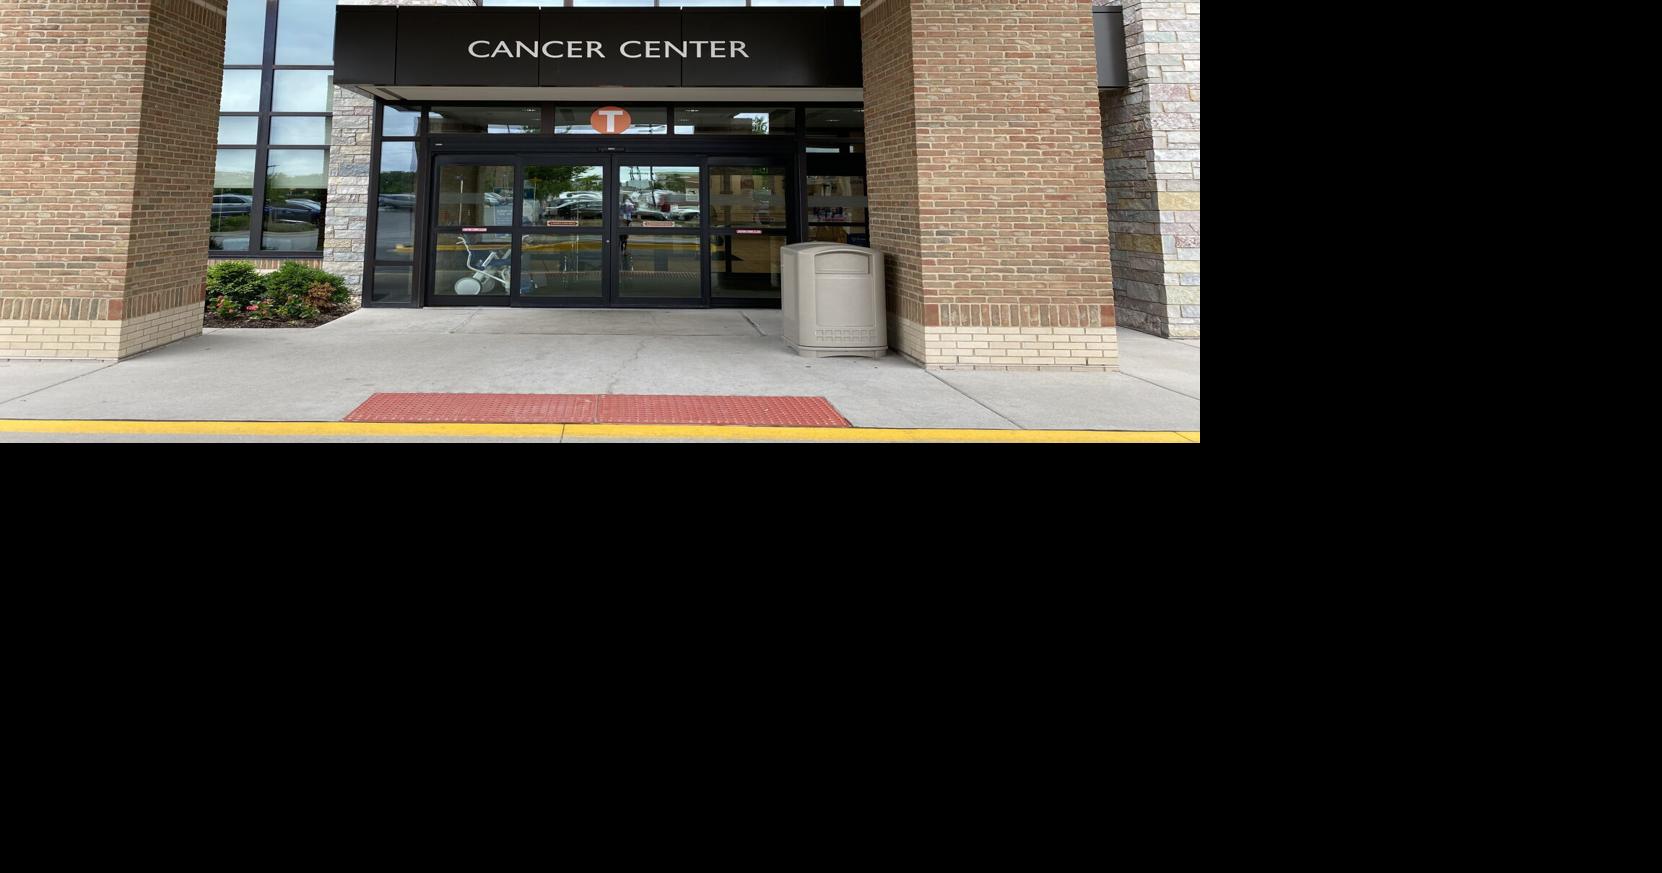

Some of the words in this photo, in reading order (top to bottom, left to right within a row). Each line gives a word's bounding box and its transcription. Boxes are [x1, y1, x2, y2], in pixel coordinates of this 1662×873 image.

[468, 40, 606, 58] CANCER
[619, 40, 750, 58] CENTER
[598, 110, 624, 133] T
